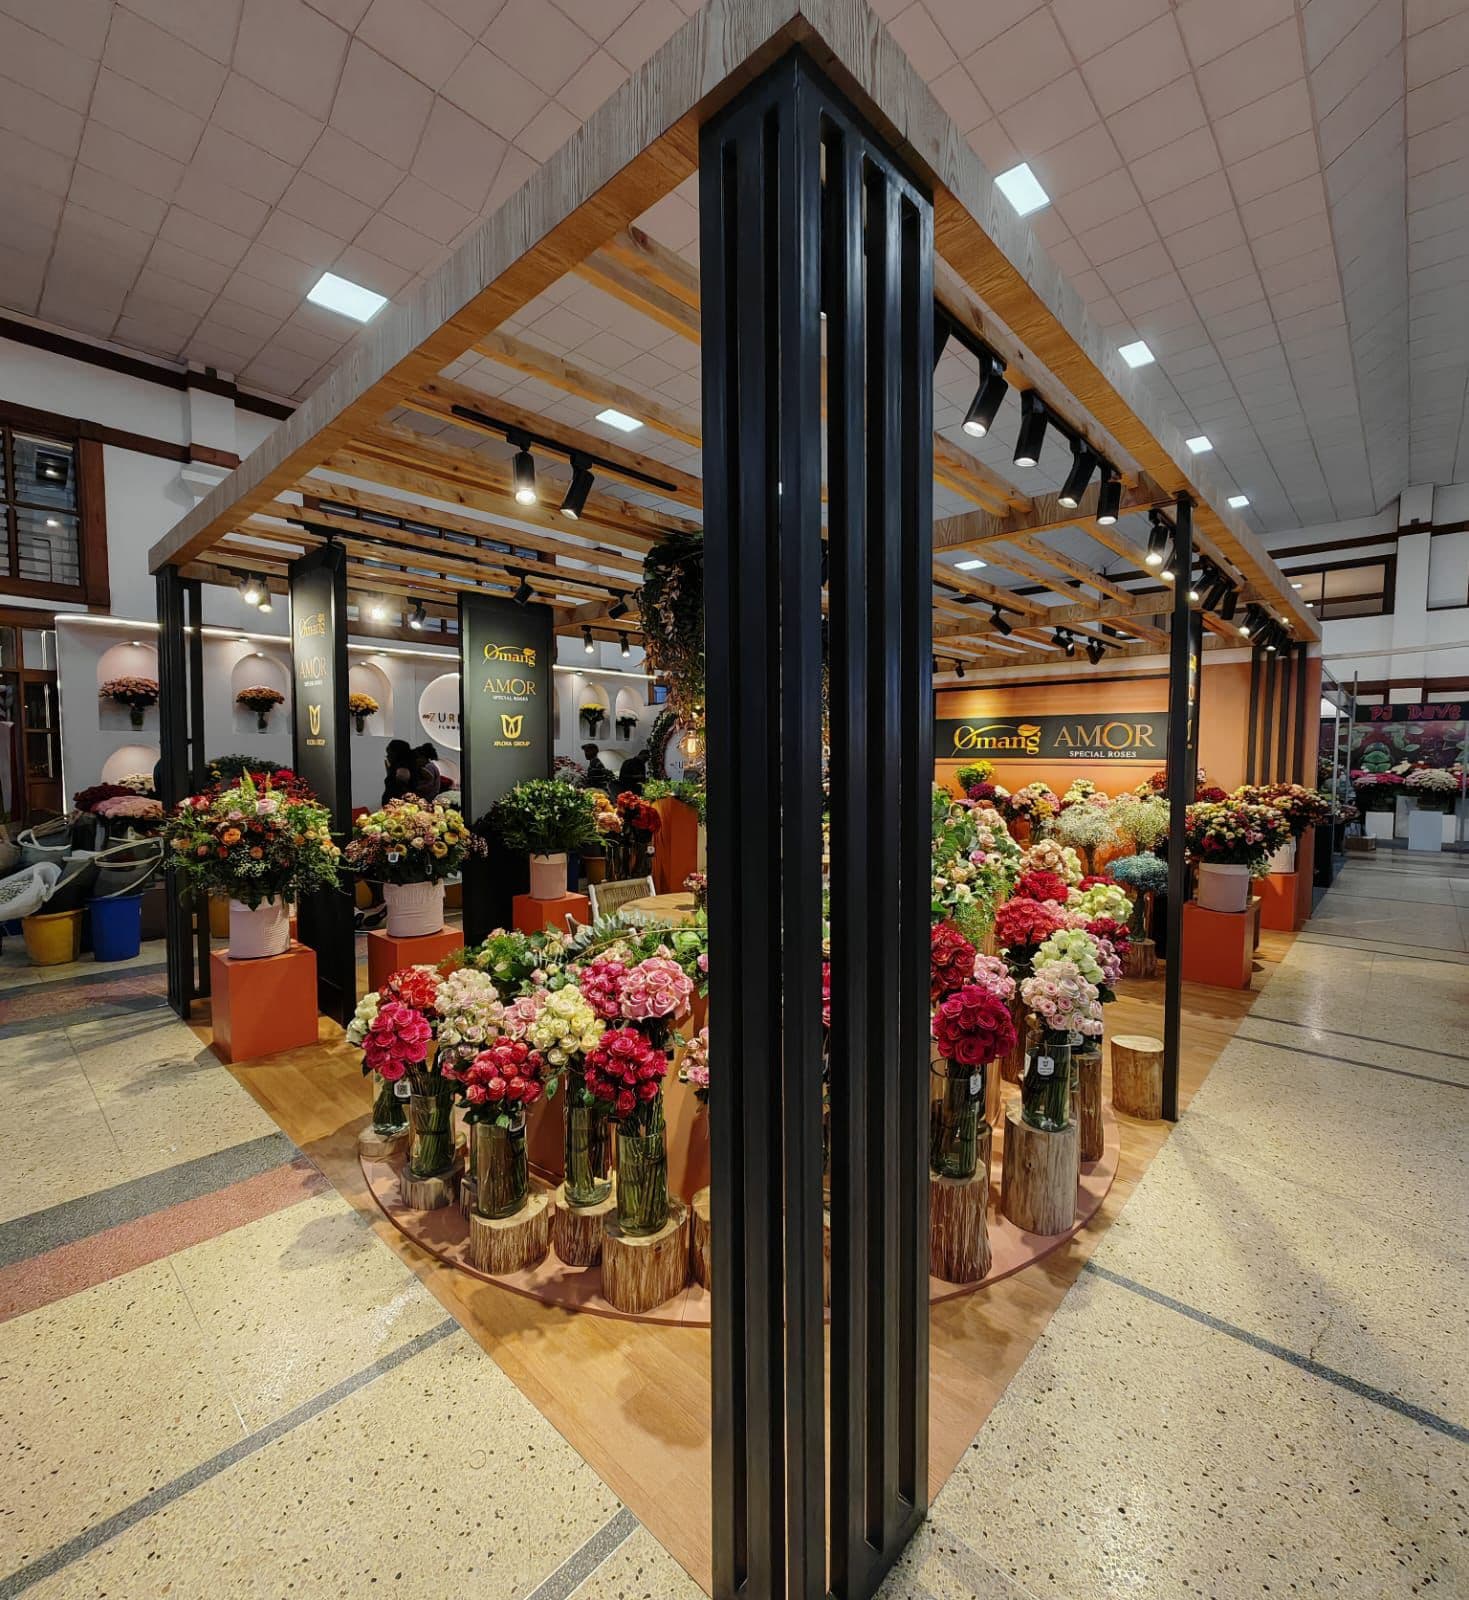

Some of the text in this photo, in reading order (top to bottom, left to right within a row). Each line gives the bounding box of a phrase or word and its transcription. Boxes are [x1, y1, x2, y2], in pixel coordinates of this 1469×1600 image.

[298, 613, 326, 639] Omang
[299, 656, 327, 679] AMOR
[482, 643, 537, 668] Omang
[483, 678, 537, 696] AMOR
[951, 723, 1042, 757] Omang
[1053, 721, 1157, 751] AMOR
[1069, 750, 1137, 759] SPECIAL ROSES
